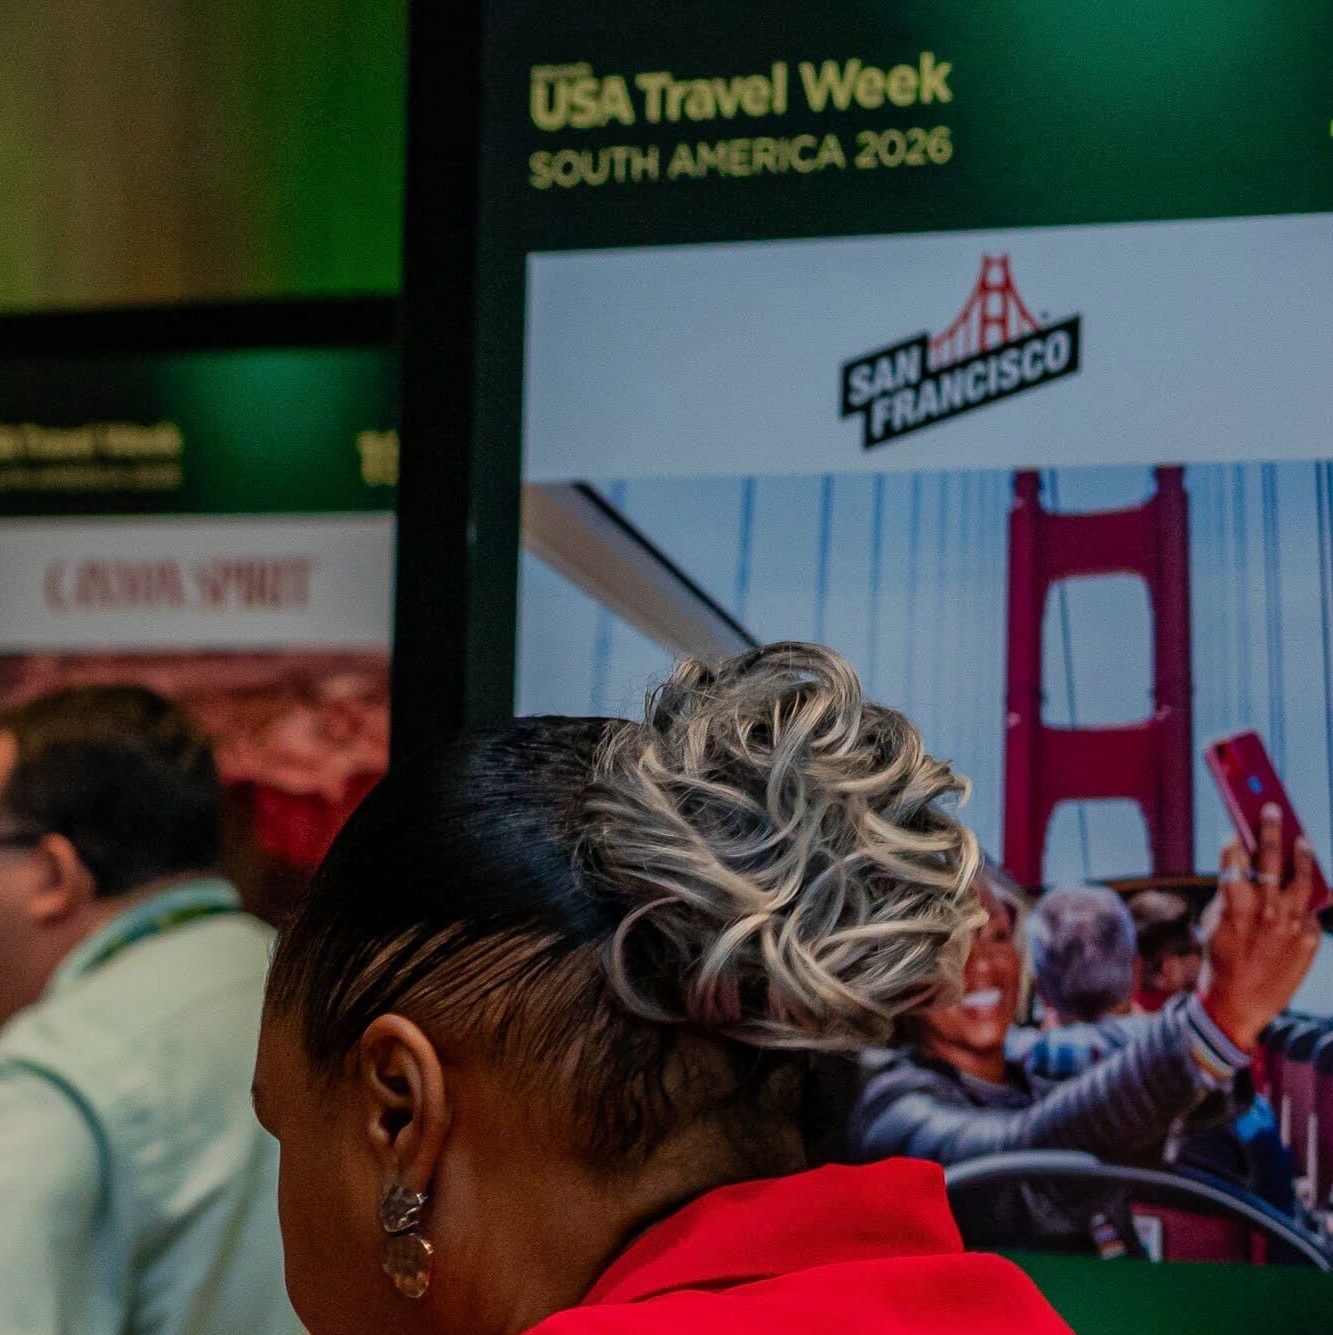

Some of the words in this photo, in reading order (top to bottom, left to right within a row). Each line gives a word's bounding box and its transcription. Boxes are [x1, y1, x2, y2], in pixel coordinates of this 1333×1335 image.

[531, 75, 635, 131] USA
[635, 60, 789, 124] Travel
[798, 51, 953, 113] Week
[529, 144, 661, 190] SOUTH
[667, 133, 846, 181] AMERICA
[853, 125, 953, 170] 2026
[847, 344, 922, 408] SAN
[869, 329, 1072, 440] FRANCISCO
